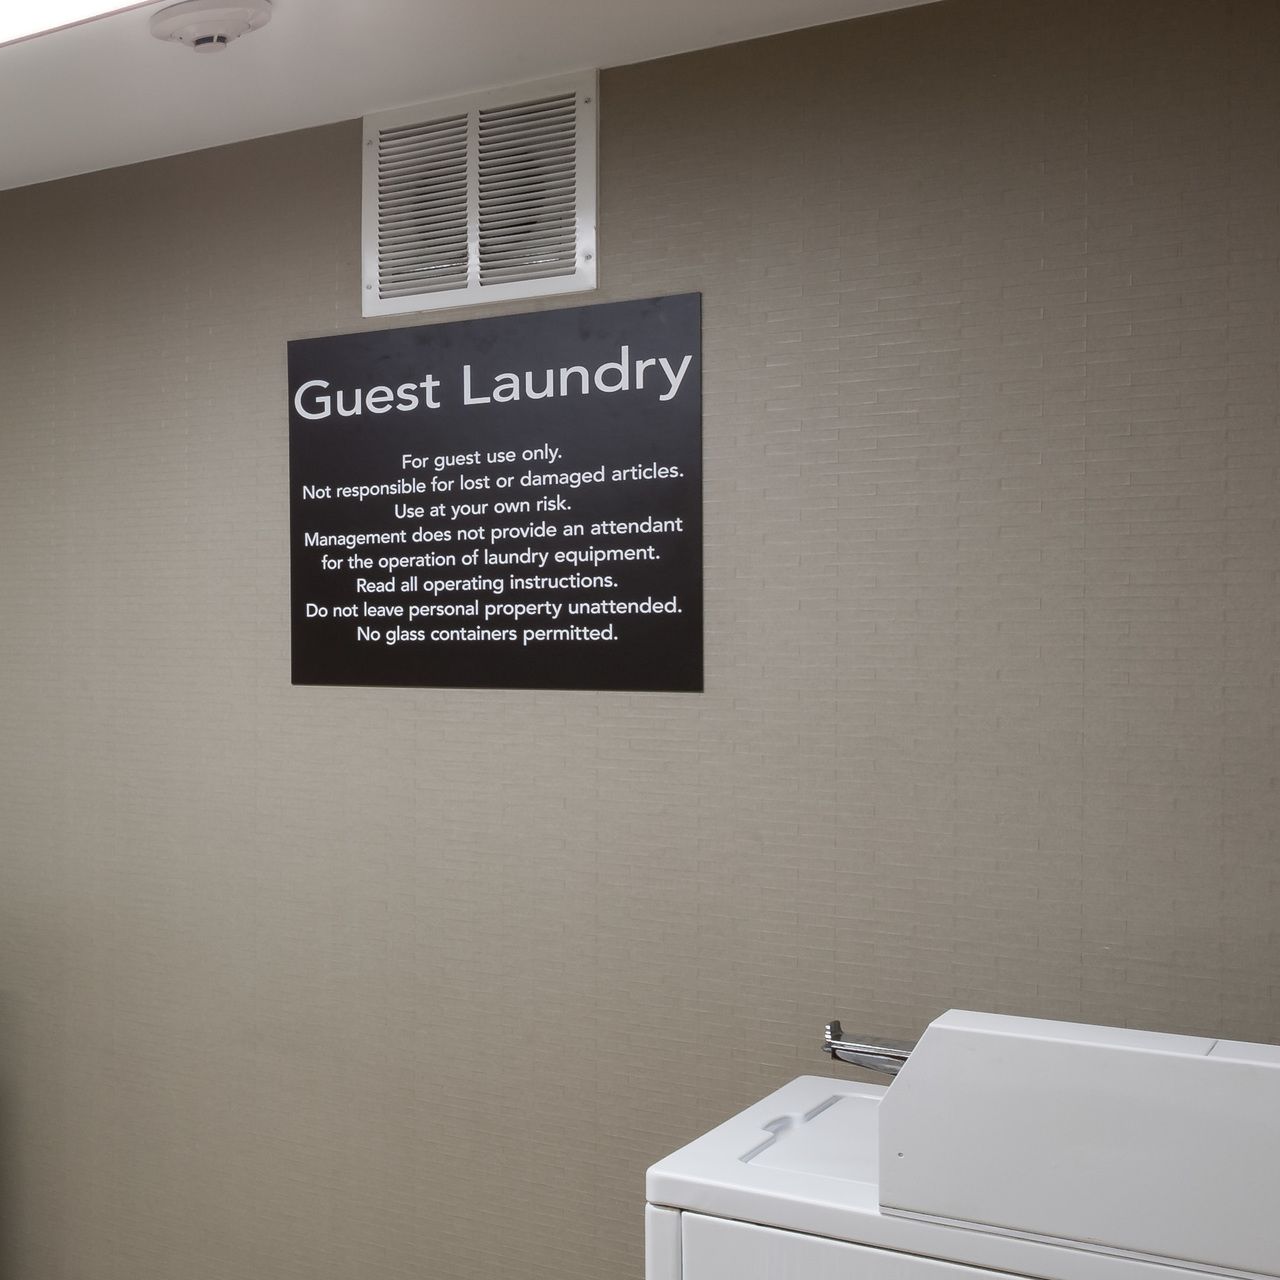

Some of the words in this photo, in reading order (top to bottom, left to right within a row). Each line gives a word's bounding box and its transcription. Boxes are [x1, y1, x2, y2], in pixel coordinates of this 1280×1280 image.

[294, 373, 441, 421] Guest
[463, 344, 693, 406] Laundry
[402, 453, 430, 470] For
[433, 450, 482, 472] guest
[486, 450, 517, 464] use
[521, 442, 563, 465] only.
[302, 484, 332, 500] Not
[336, 477, 427, 502] responsible
[430, 475, 455, 493] for
[460, 473, 491, 491] lost
[495, 475, 515, 489] or
[519, 464, 606, 489] damaged
[611, 461, 685, 482] articles.
[394, 503, 425, 520] Use
[429, 503, 447, 518] at
[450, 502, 489, 521] your
[493, 500, 531, 514] own
[536, 493, 572, 512] risk.
[304, 529, 407, 550] Management
[411, 525, 452, 543] does
[457, 525, 486, 541] not
[490, 520, 558, 545] provide
[562, 524, 585, 537] an
[590, 515, 684, 536] attendant
[320, 553, 344, 571] for
[346, 553, 374, 570] the
[377, 551, 456, 574] operation
[461, 548, 480, 566] of
[484, 546, 550, 568] laundry
[553, 545, 661, 568] equipment.
[356, 576, 396, 593] Read
[400, 575, 418, 593] all
[422, 574, 505, 597] operating
[509, 572, 619, 590] instructions.
[305, 602, 329, 618] Do
[332, 603, 359, 618] not
[363, 600, 405, 618] leave
[408, 599, 479, 622] personal
[484, 600, 563, 621] property
[568, 595, 683, 615] unattended.
[356, 625, 382, 642] No
[385, 624, 426, 646] glass
[430, 624, 518, 642] containers
[522, 623, 619, 647] permitted.
